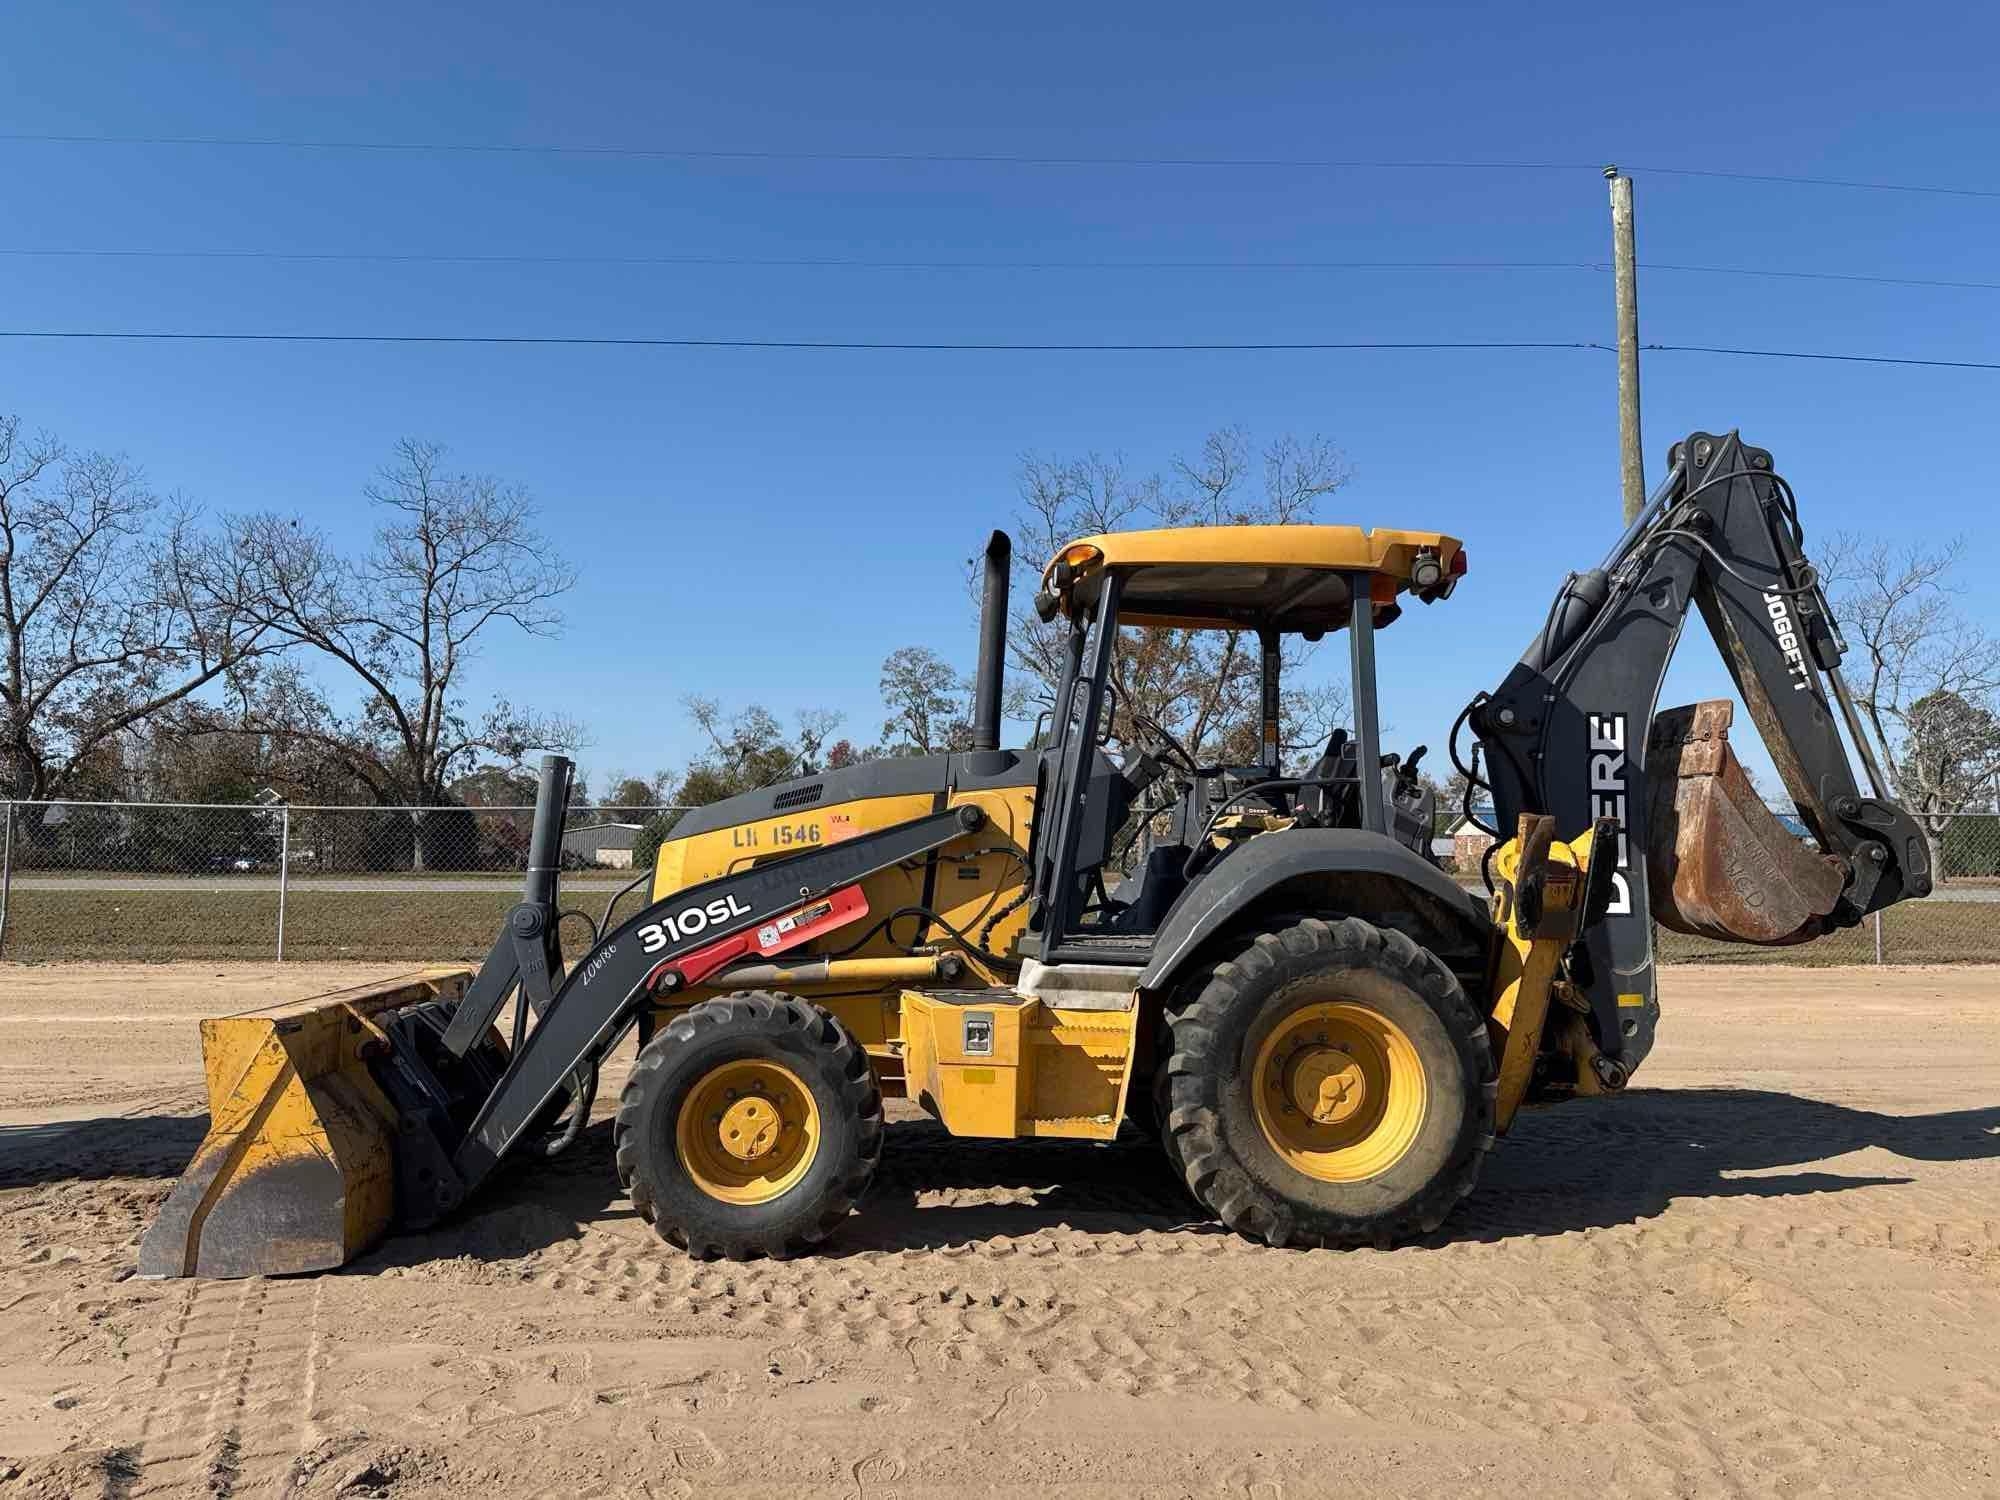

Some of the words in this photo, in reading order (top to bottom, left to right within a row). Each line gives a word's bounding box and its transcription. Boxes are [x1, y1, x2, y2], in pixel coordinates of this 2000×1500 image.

[773, 824, 820, 845] 1546
[1590, 716, 1631, 914] DERE
[638, 894, 751, 953] 310SL
